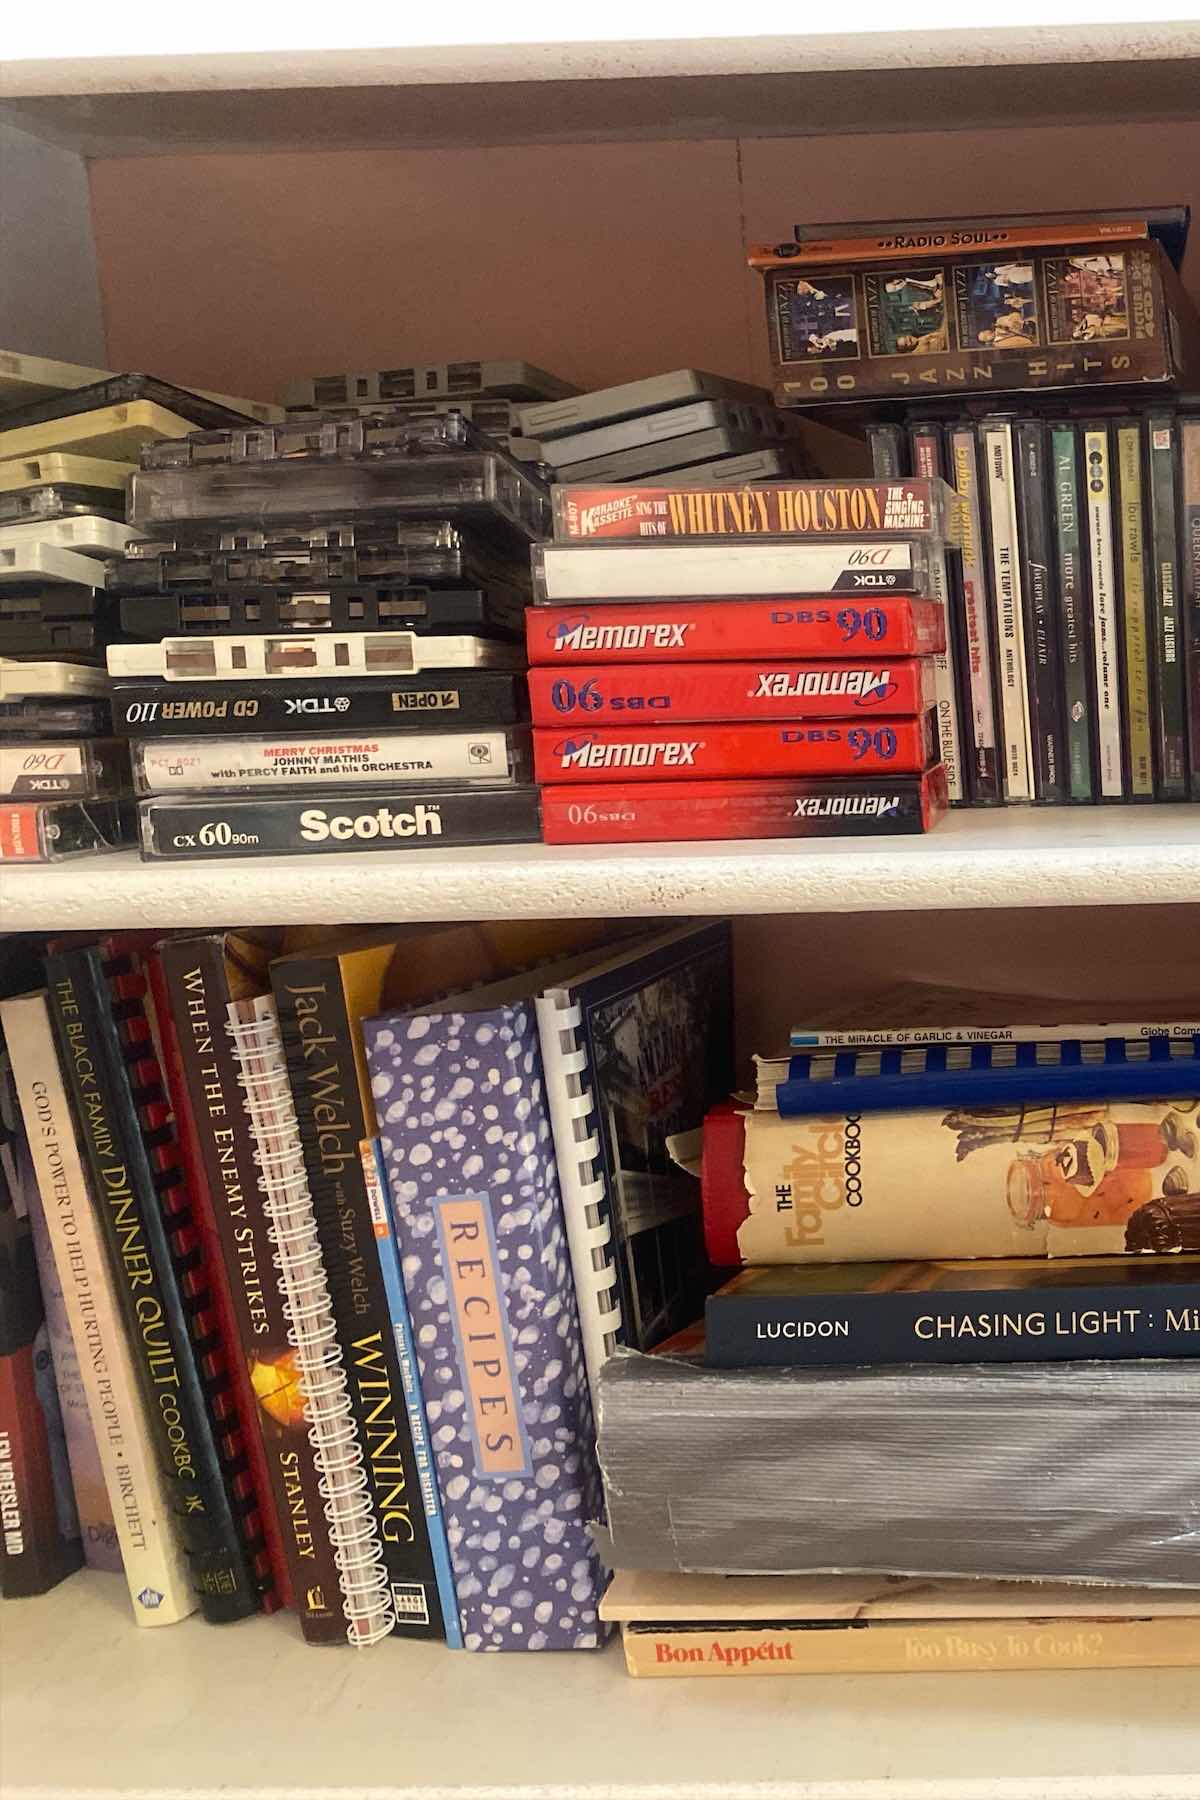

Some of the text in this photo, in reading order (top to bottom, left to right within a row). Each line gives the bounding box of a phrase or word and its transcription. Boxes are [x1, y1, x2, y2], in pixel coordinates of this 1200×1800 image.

[894, 231, 993, 249] RADIO SOUL
[892, 356, 1131, 385] JAZZ HITS
[887, 487, 904, 500] THE
[668, 488, 880, 534] WHITNEY HOUSTON
[884, 514, 926, 529] MACHINE
[848, 548, 891, 564] D90
[1058, 456, 1079, 663] AL GREEN more greatest hits
[1128, 527, 1141, 562] rawls
[853, 574, 886, 586] TDK
[1000, 548, 1014, 638] THE TEMPTATIONS
[552, 608, 888, 652] Memorex DBS 90
[969, 647, 981, 673] hits
[551, 669, 893, 713] Memorex DBS 90
[126, 698, 335, 722] TDK CD POWER 110
[264, 744, 379, 757] MERRY CHRISTMAS
[560, 727, 897, 769] Memorex DBS 90
[938, 700, 957, 787] ON THE BLUE SIDE
[24, 754, 64, 770] D60
[211, 761, 433, 778] with PERCY FAITH and his ORCHESTRA
[273, 753, 369, 767] JOHNNY MATHIS
[30, 779, 62, 790] TDK
[300, 805, 442, 841] Scotch
[568, 795, 899, 825] Memorex 90
[199, 822, 232, 847] 60
[284, 983, 337, 1060] Jack
[824, 1030, 1014, 1045] THE MIRACLE OF GARLIC VINEGAR
[307, 1063, 358, 1177] Welch
[55, 978, 180, 1388] THE BLACK FAMILY DINNER QUILT
[775, 1184, 792, 1213] THE
[336, 1207, 361, 1255] Suzy
[182, 967, 315, 1560] WHEN THE ENEMY STRIKES STANLEY
[347, 1255, 372, 1315] Welch
[32, 1081, 147, 1551] GOD'S POWER TO HELP HURTING PEOPLE BIRCHETT
[756, 1319, 849, 1339] LUCIDON
[914, 1311, 1045, 1340] CHASING
[449, 1220, 513, 1454] RECIPES
[350, 1329, 415, 1544] WINNING
[410, 1415, 437, 1516] RECIPE FOR DISASTER
[5, 1531, 24, 1555] MD
[656, 1635, 998, 1667] Bon Appétit Busy
